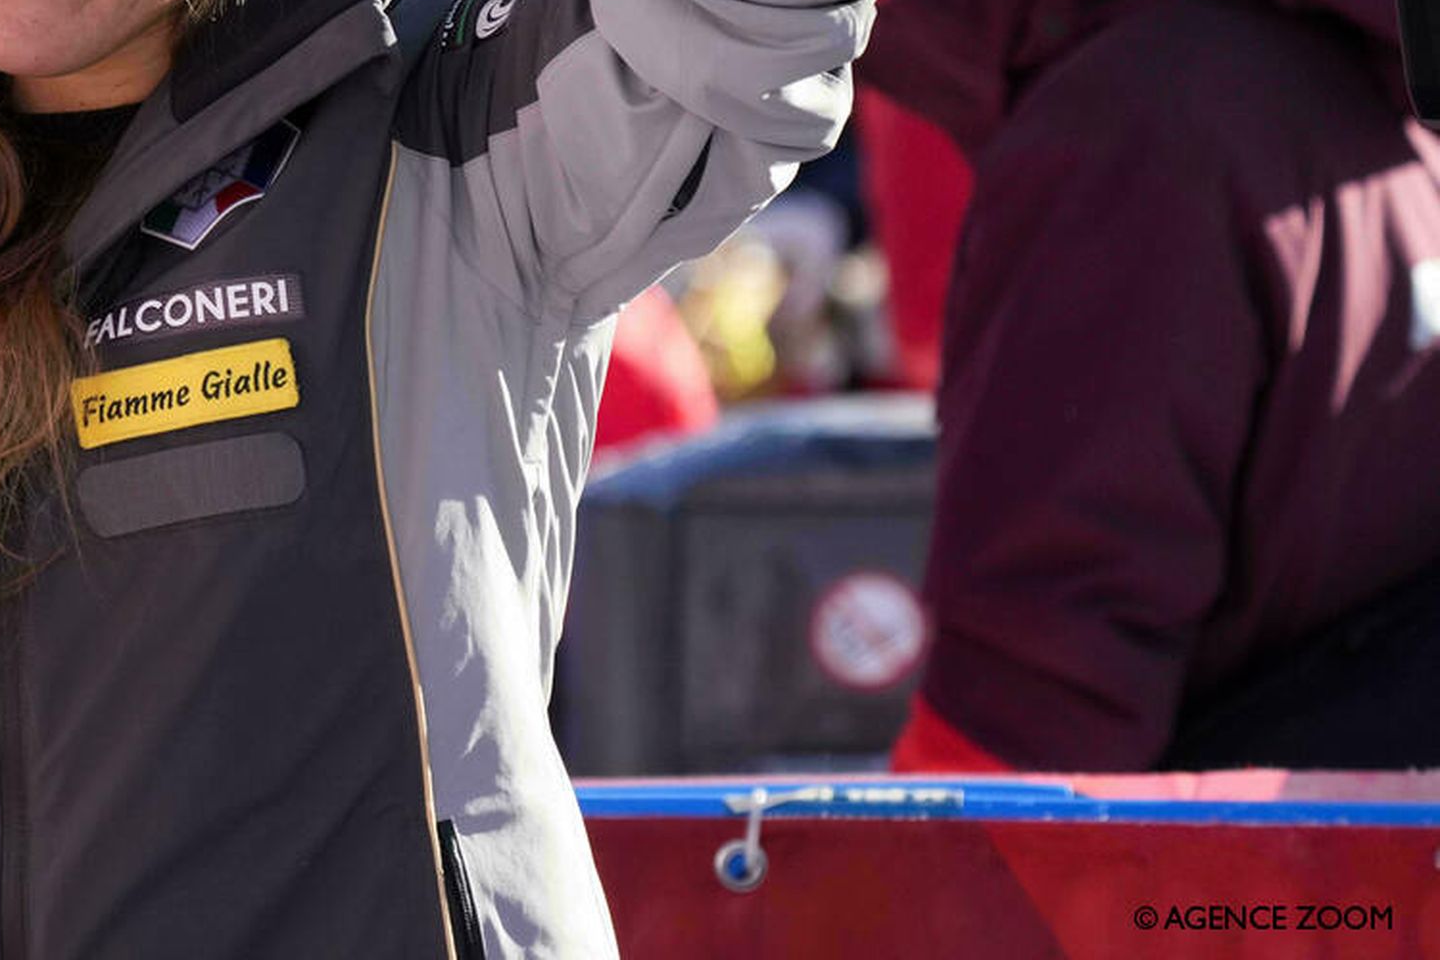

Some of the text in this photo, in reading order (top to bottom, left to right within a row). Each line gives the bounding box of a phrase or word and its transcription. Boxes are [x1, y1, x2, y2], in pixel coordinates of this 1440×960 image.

[84, 279, 289, 350] FALCONERI
[82, 360, 288, 428] Fiamme Gialle
